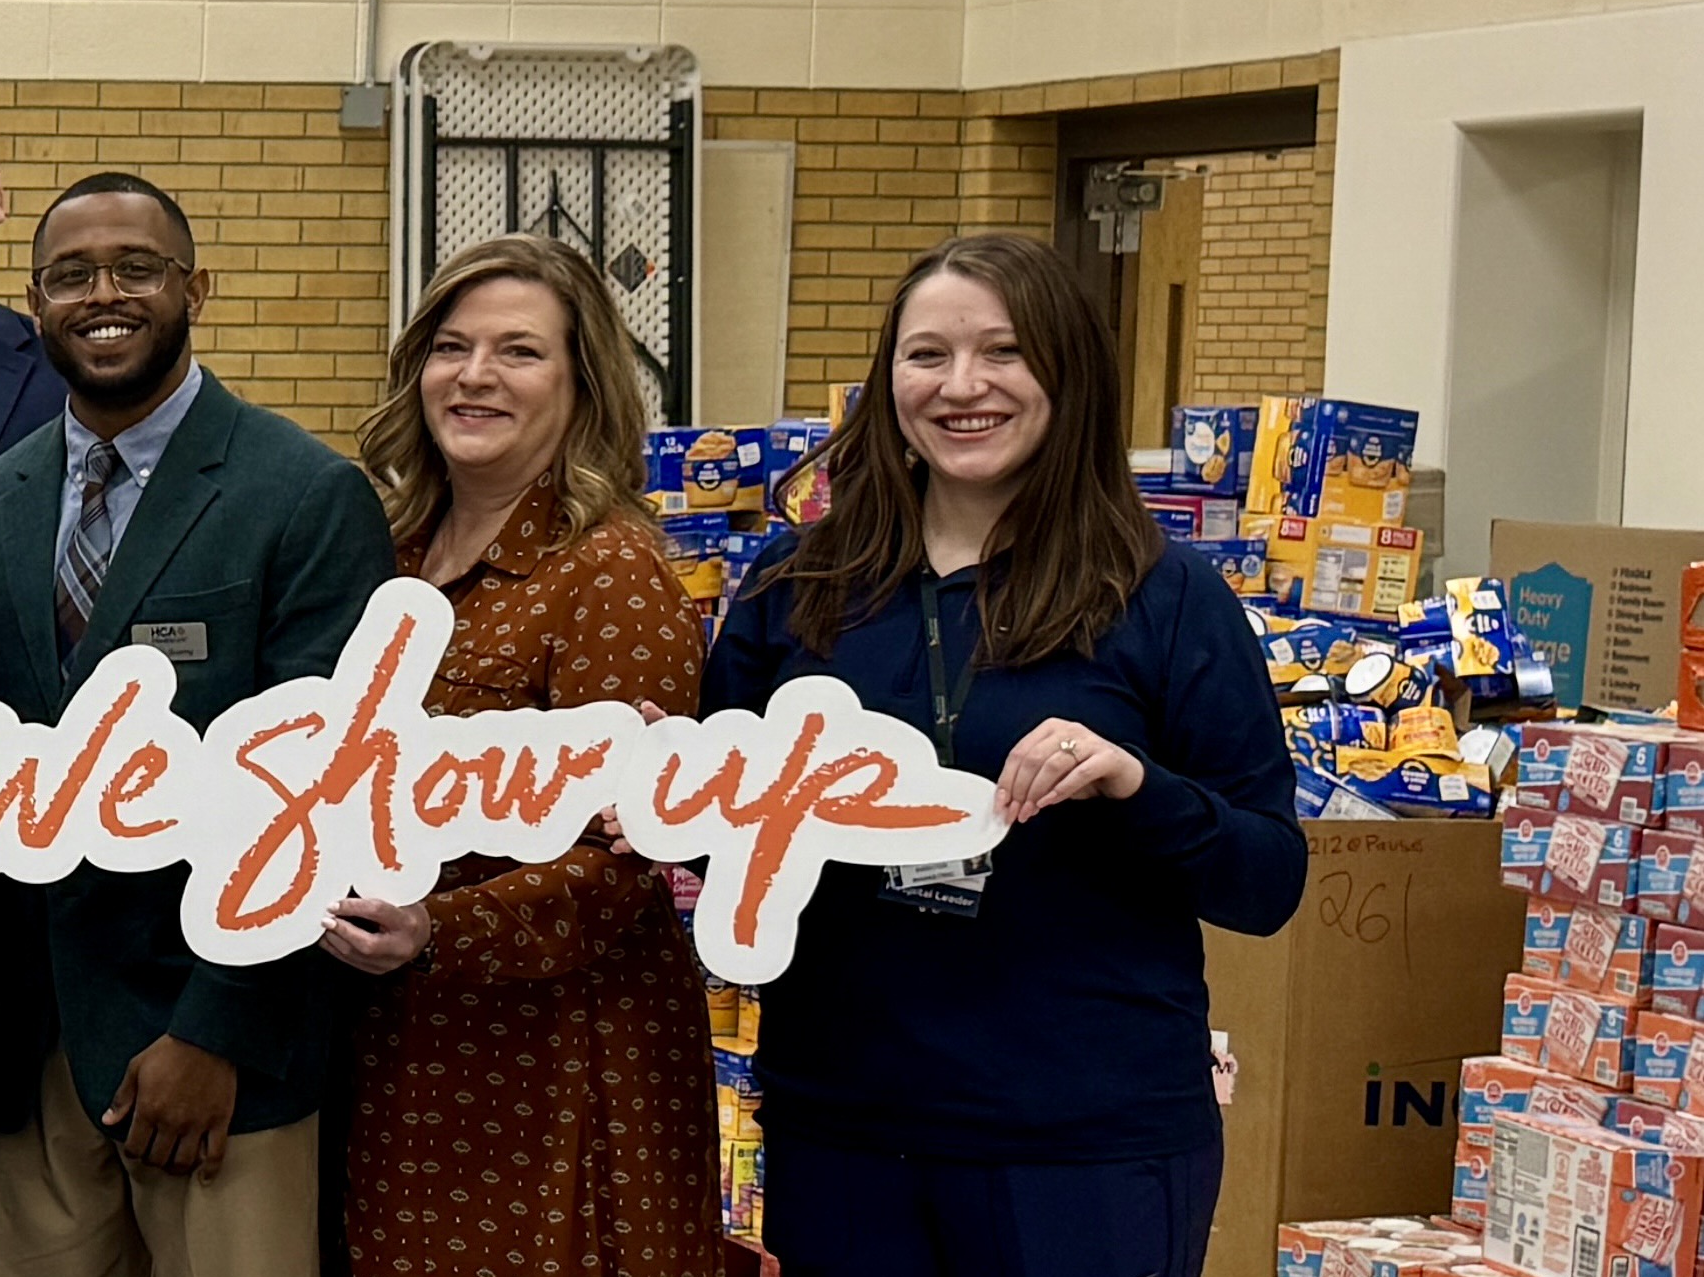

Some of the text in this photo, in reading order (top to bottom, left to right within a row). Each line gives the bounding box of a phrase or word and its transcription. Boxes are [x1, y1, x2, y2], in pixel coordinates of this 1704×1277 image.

[1519, 586, 1565, 608] Heavy
[1517, 606, 1551, 630] Duty
[1635, 746, 1646, 766] 6
[654, 711, 972, 947] up
